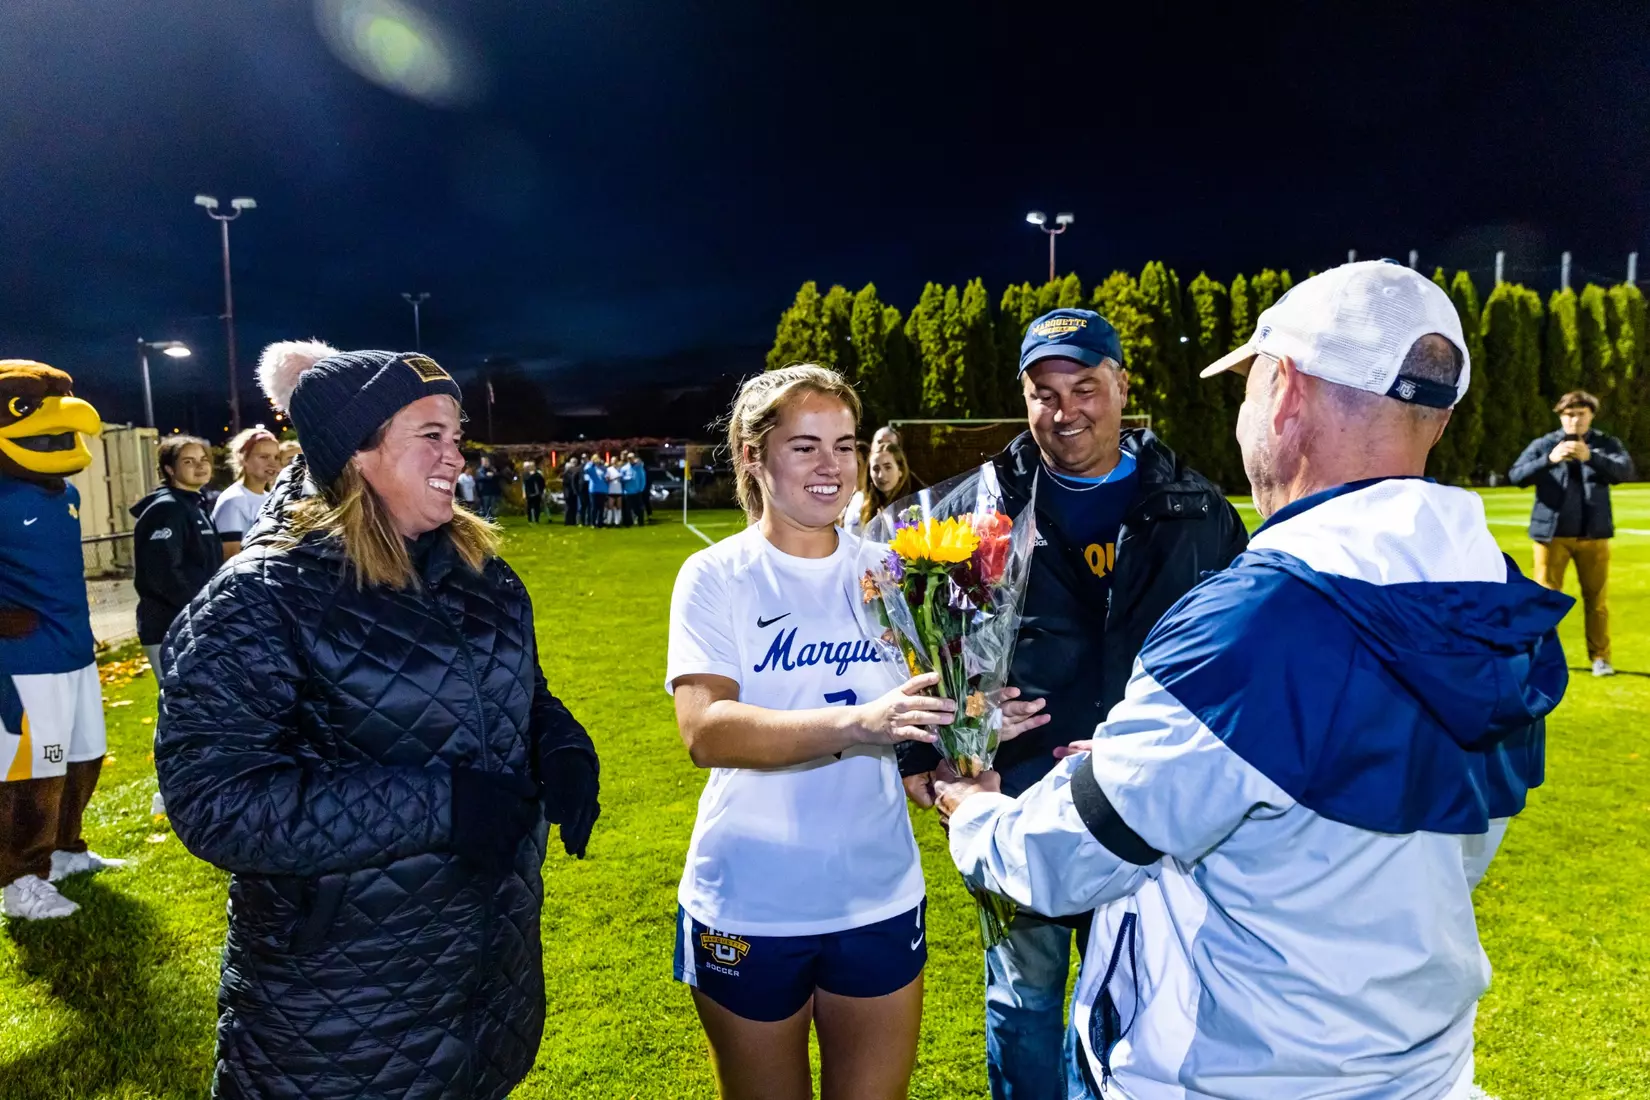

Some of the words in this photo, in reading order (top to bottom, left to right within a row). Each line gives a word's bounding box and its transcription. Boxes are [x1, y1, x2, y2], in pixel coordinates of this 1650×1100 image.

[753, 626, 903, 677] Marque
[43, 744, 64, 763] MU
[705, 961, 740, 977] SOCCER
